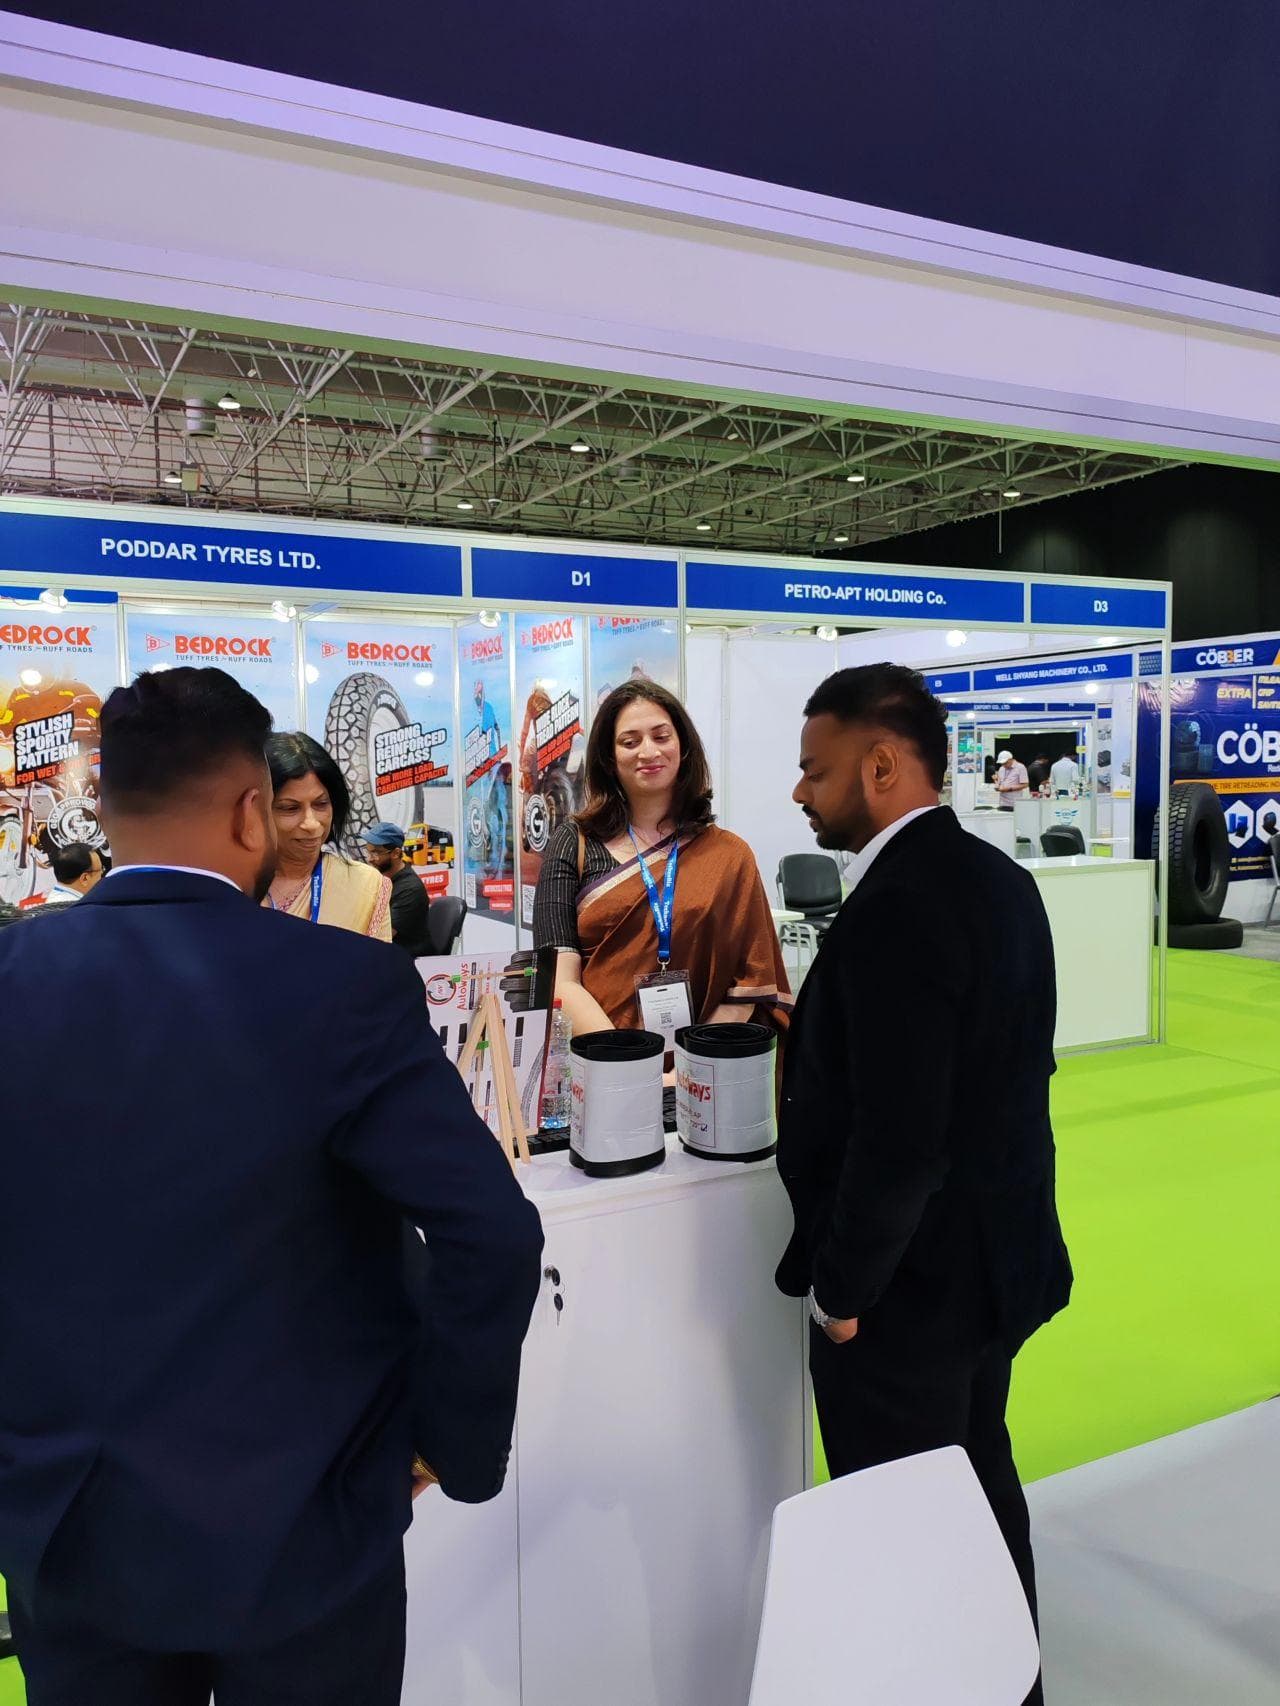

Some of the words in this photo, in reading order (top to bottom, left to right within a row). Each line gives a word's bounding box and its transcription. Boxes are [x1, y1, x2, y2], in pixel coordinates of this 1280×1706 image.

[101, 538, 197, 560] PODDAR
[202, 545, 272, 566] TYRES
[278, 551, 321, 569] LTD.
[572, 571, 591, 586] D1
[785, 584, 862, 600] PETRO-APT
[865, 588, 923, 604] HOLDING
[927, 591, 947, 605] Co.
[1094, 600, 1108, 612] D3
[0, 624, 91, 646] EDROCK
[532, 617, 573, 646] BEDROCK
[175, 635, 272, 656] BEDROCK
[347, 642, 432, 662] BEDROCK
[1196, 648, 1254, 666] CÖBBER
[995, 673, 1012, 682] WELL
[1013, 671, 1038, 680] SHYANG
[1039, 667, 1077, 678] MACHINERY
[1093, 664, 1108, 672] LTD.
[1217, 687, 1251, 699] EXTRA
[16, 713, 72, 741] STYLISH
[376, 724, 421, 748] STRONG
[16, 729, 70, 756] SPORTY
[377, 730, 446, 761] REINFORCED
[17, 741, 78, 771] PATTERN
[377, 749, 430, 775] CARCASS
[16, 770, 35, 785] FOR
[37, 765, 57, 780] WET
[377, 774, 390, 786] FOR
[414, 766, 448, 783] CAPACITY
